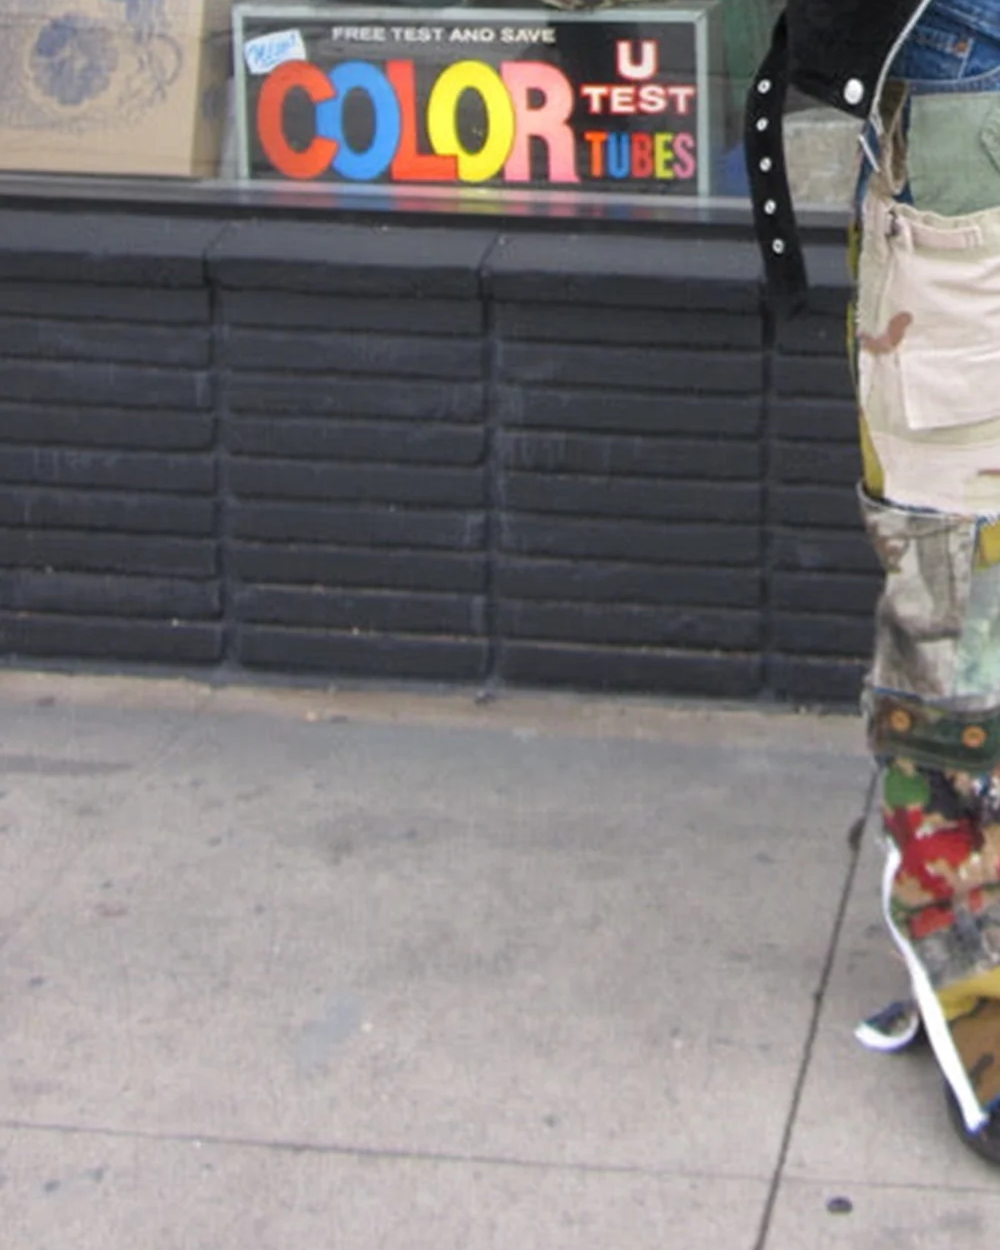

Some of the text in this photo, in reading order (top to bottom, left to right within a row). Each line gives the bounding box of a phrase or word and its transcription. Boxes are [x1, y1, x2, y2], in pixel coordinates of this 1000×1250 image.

[331, 26, 556, 43] FREE TEST AND SAVE
[616, 39, 657, 79] U
[580, 84, 695, 114] TEST
[257, 59, 580, 183] COLOR
[584, 131, 695, 179] TUBES
